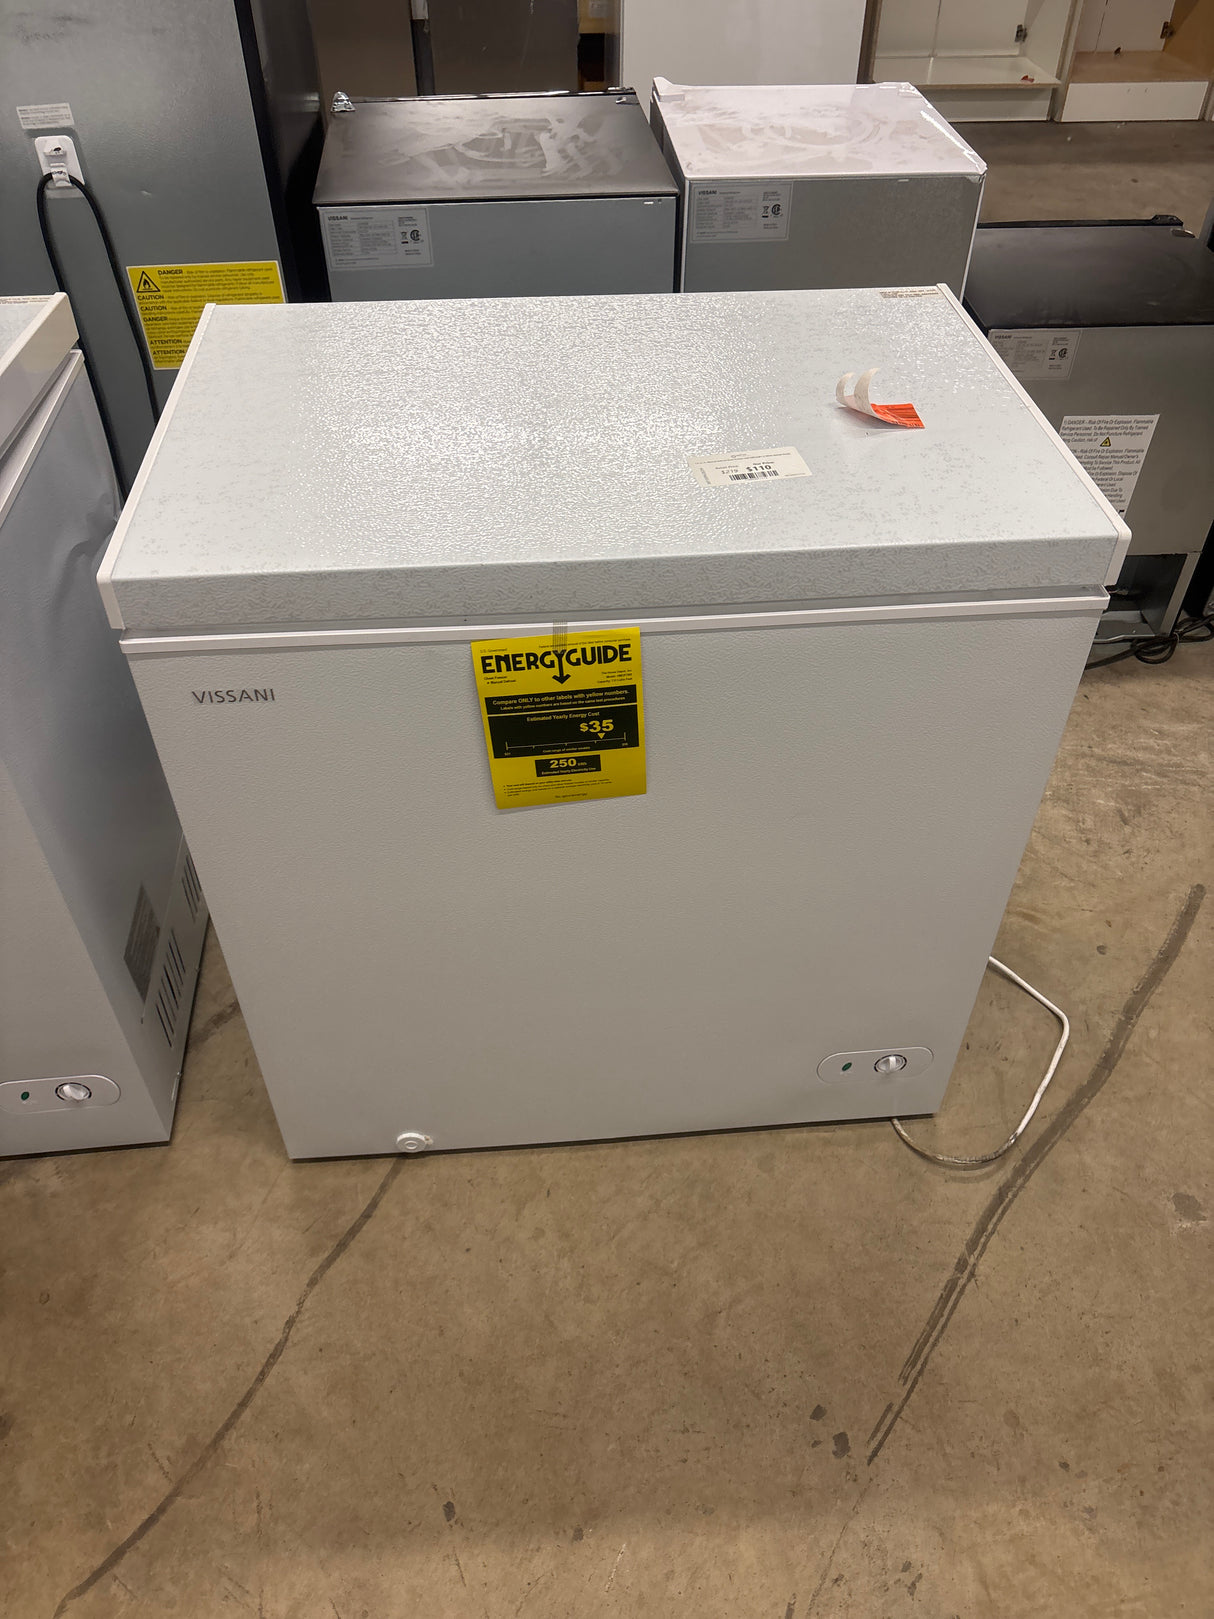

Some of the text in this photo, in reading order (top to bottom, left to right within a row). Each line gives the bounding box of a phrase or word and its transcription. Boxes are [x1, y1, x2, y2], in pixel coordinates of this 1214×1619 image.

[480, 644, 632, 674] ENERGYGUIDE
[192, 688, 276, 703] VISSANI
[580, 719, 614, 733] $35
[550, 758, 577, 768] 250
